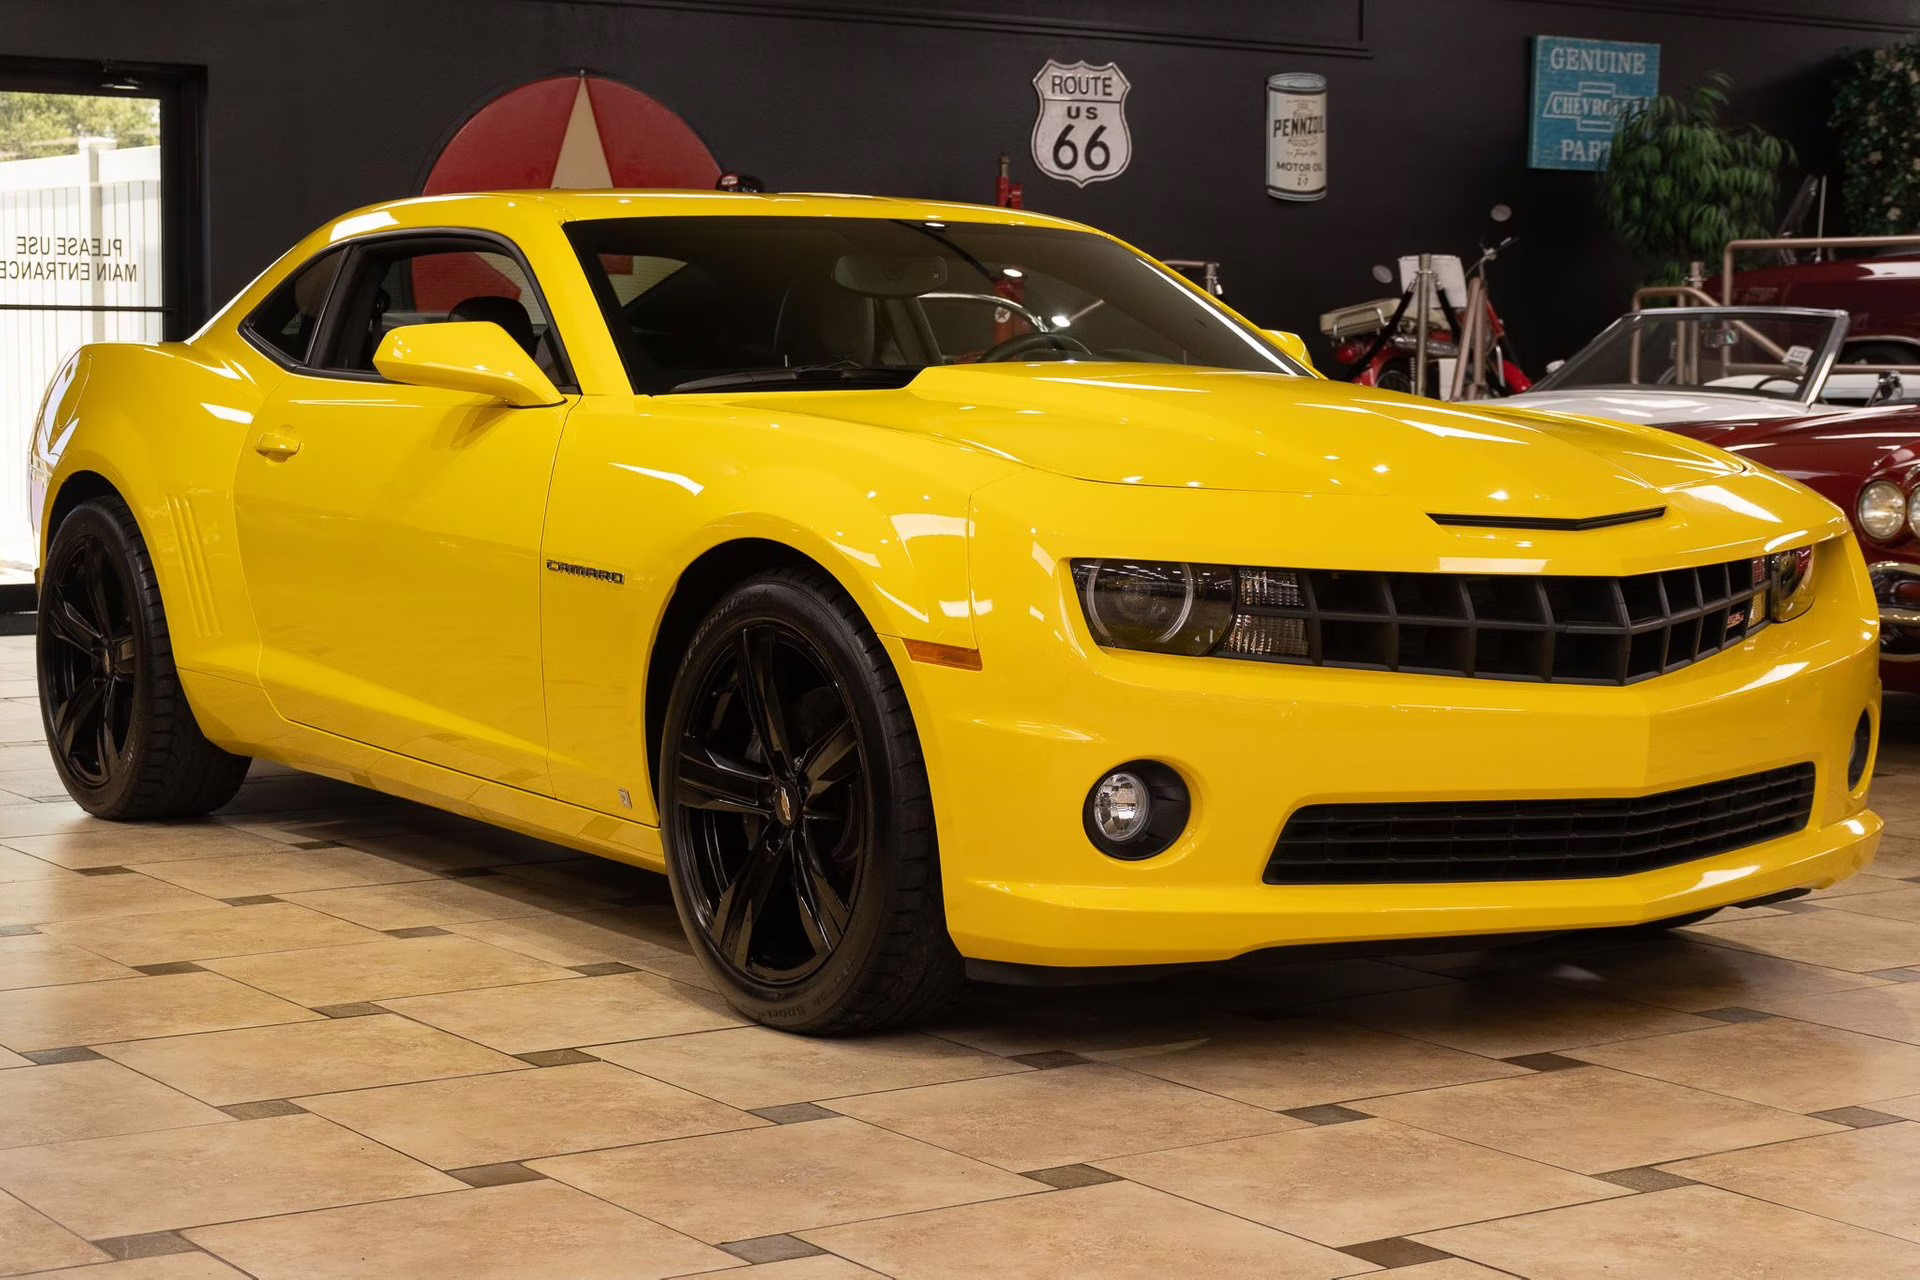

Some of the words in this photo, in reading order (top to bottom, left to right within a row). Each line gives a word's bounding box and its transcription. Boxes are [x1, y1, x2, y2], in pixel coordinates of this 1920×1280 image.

[1550, 47, 1646, 75] GENUINE
[1051, 75, 1113, 96] ROUTE
[1066, 106, 1099, 120] US
[1052, 123, 1111, 172] 66
[1560, 139, 1613, 162] PART
[1276, 161, 1311, 172] MOTOR
[546, 559, 625, 585] CAMARO
